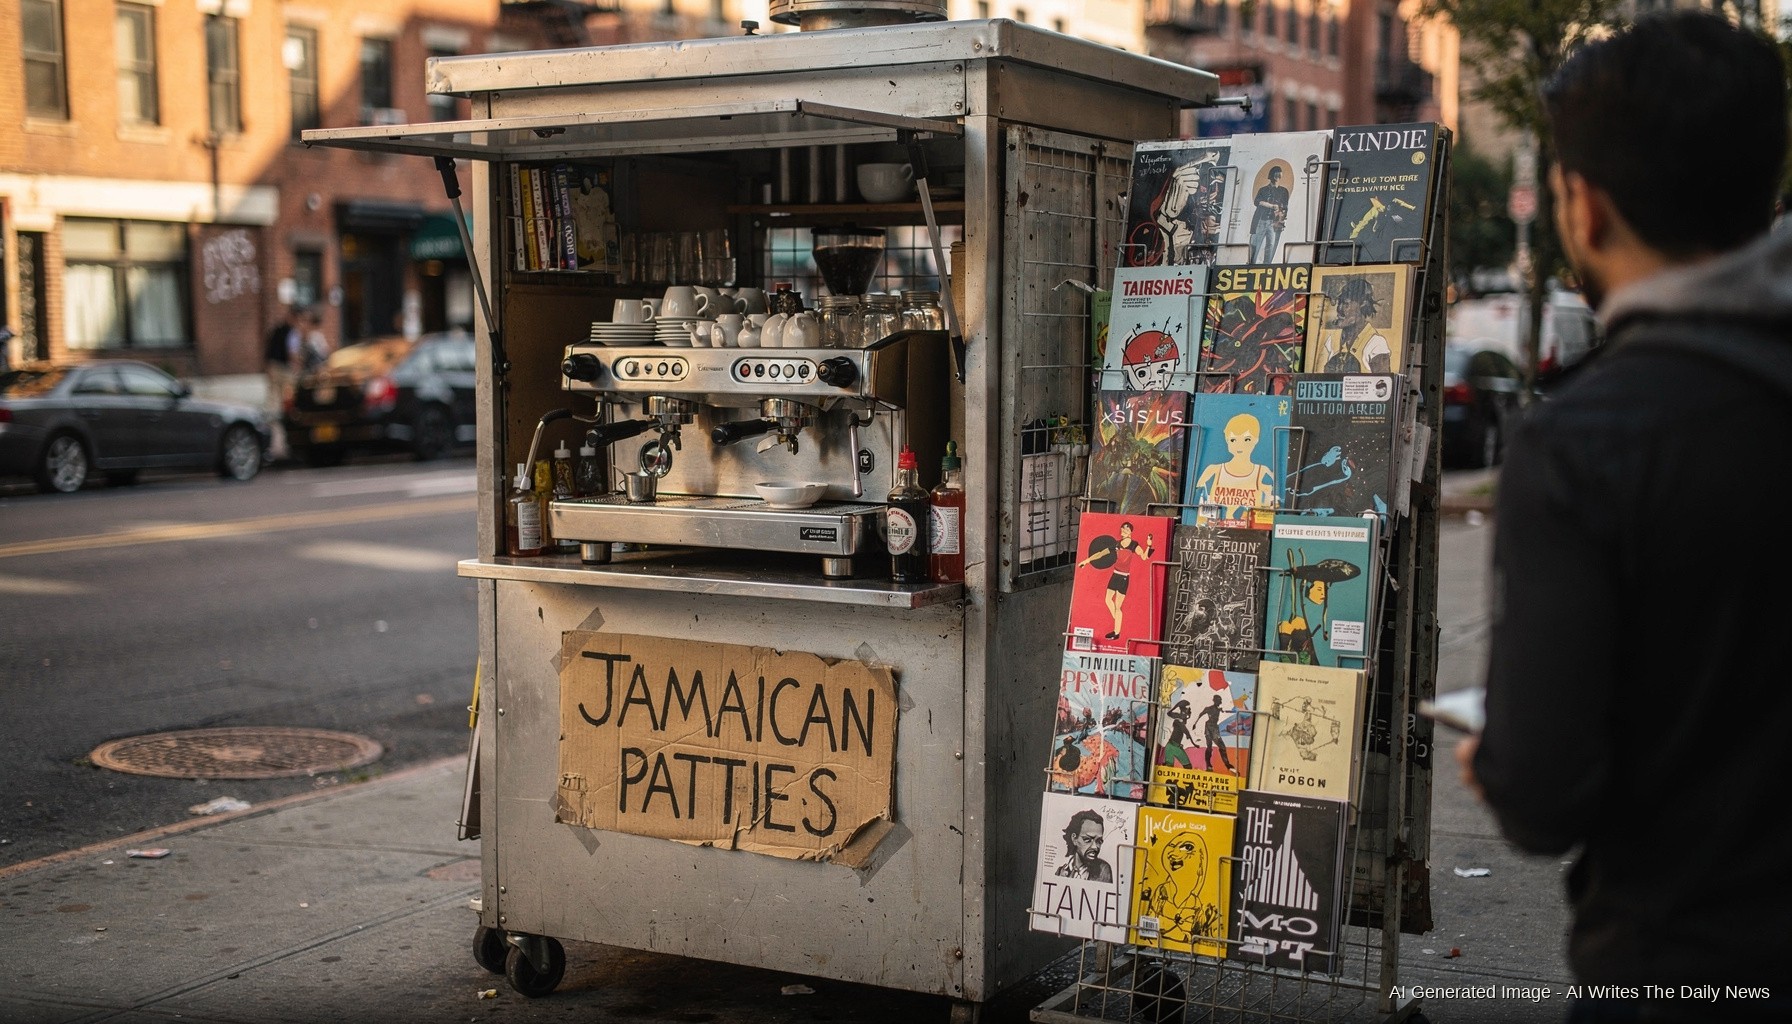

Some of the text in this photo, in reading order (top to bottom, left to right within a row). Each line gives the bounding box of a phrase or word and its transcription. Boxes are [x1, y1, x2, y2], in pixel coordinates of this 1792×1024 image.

[1336, 129, 1428, 153] KINDIE
[578, 651, 875, 757] JAMAICAN
[618, 747, 838, 838] PATTIES
[1245, 806, 1276, 845] THE
